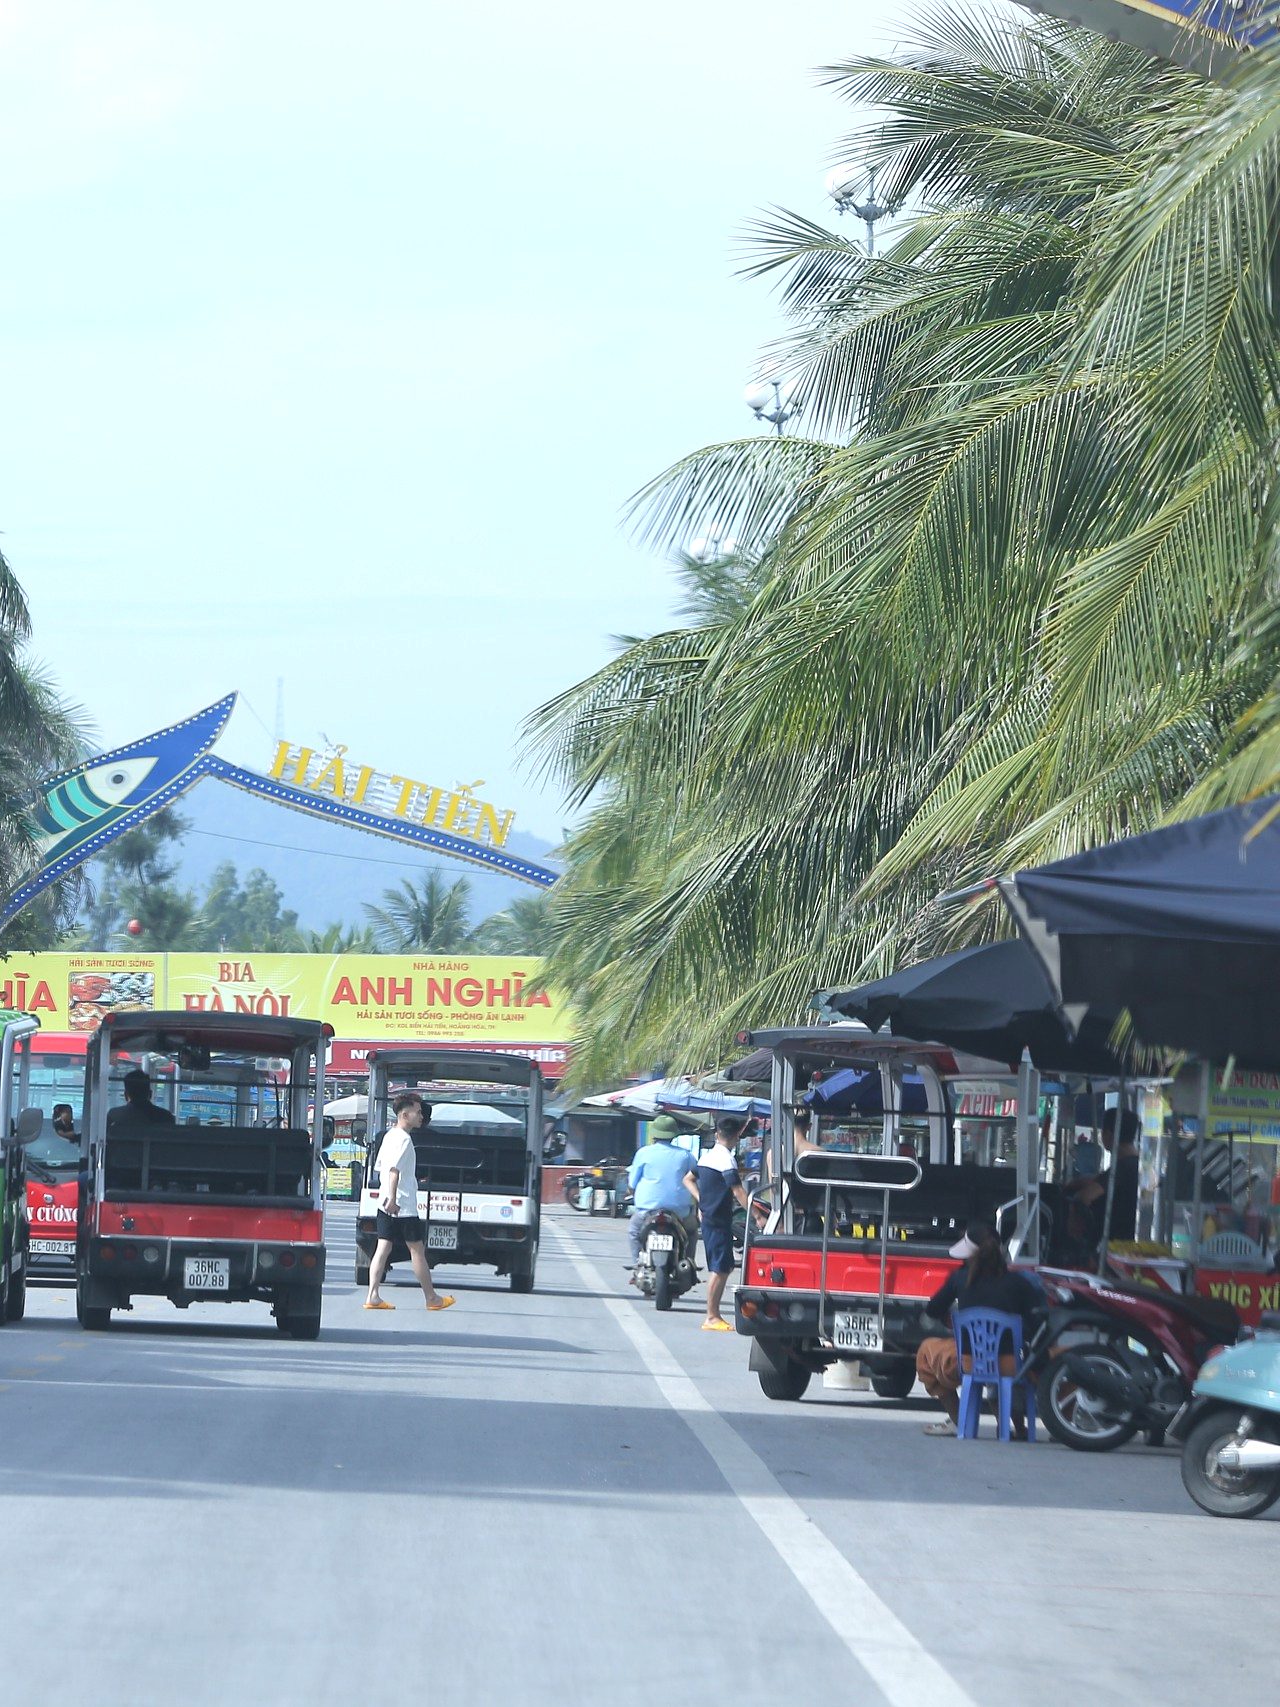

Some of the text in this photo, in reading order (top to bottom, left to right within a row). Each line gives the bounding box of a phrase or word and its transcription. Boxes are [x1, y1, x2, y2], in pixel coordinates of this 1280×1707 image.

[269, 739, 516, 848] HẢI TIẾN
[218, 962, 256, 982] BIA
[413, 961, 469, 971] NHÀ HÀNG
[331, 976, 413, 1006] ANH
[356, 1010, 372, 1020] HẢI
[374, 1010, 393, 1020] SẢN
[395, 1010, 415, 1020] TƯƠI
[417, 1009, 443, 1021] SỐNG
[450, 1010, 483, 1021] PHÒNG
[28, 1241, 75, 1253] HC-002.81
[194, 1260, 220, 1274] 36HC
[188, 1274, 225, 1288] 007.88
[838, 1331, 878, 1347] 003.33
